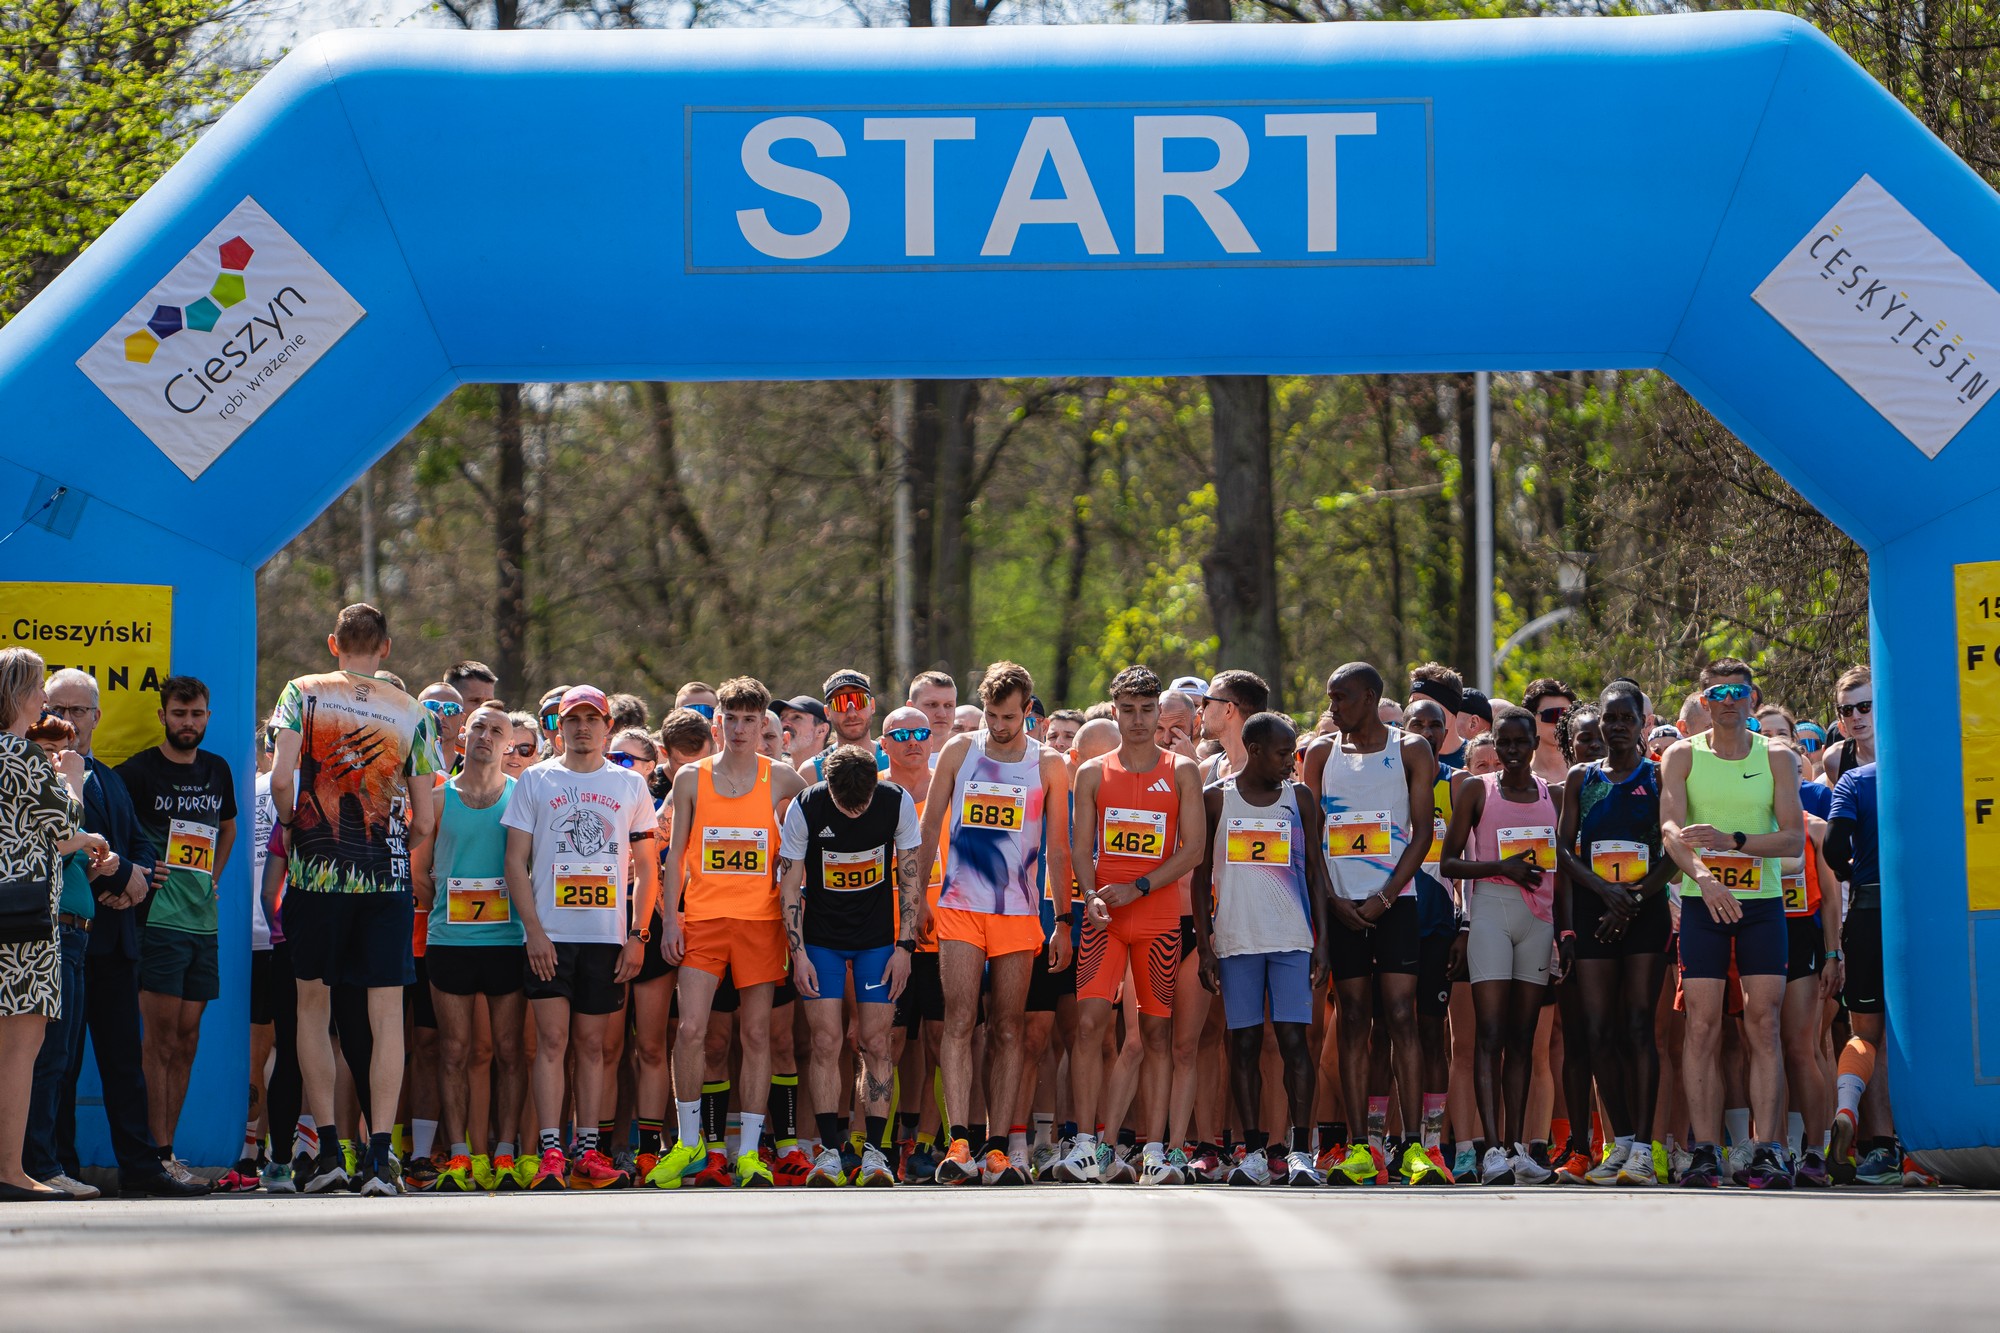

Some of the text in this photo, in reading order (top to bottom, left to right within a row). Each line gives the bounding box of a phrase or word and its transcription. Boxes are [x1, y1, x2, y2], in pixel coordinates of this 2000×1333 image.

[735, 111, 1377, 260] START
[163, 285, 308, 415] Cieszyn
[218, 332, 307, 421] robi wrażenie
[12, 617, 153, 647] Cieszyński
[1967, 643, 2000, 671] F
[346, 706, 369, 718] DOBRE
[154, 796, 173, 811] DO
[550, 794, 568, 811] SMS
[969, 804, 1015, 827] 683
[558, 843, 619, 853] 19 82
[1110, 831, 1156, 854] 462
[1251, 840, 1266, 861] 2
[1351, 833, 1368, 853] 4
[179, 844, 209, 869] 371
[711, 849, 758, 871] 548
[832, 867, 877, 888] 390
[1612, 862, 1621, 882] 1
[563, 885, 609, 906] 258
[471, 900, 486, 921] 7
